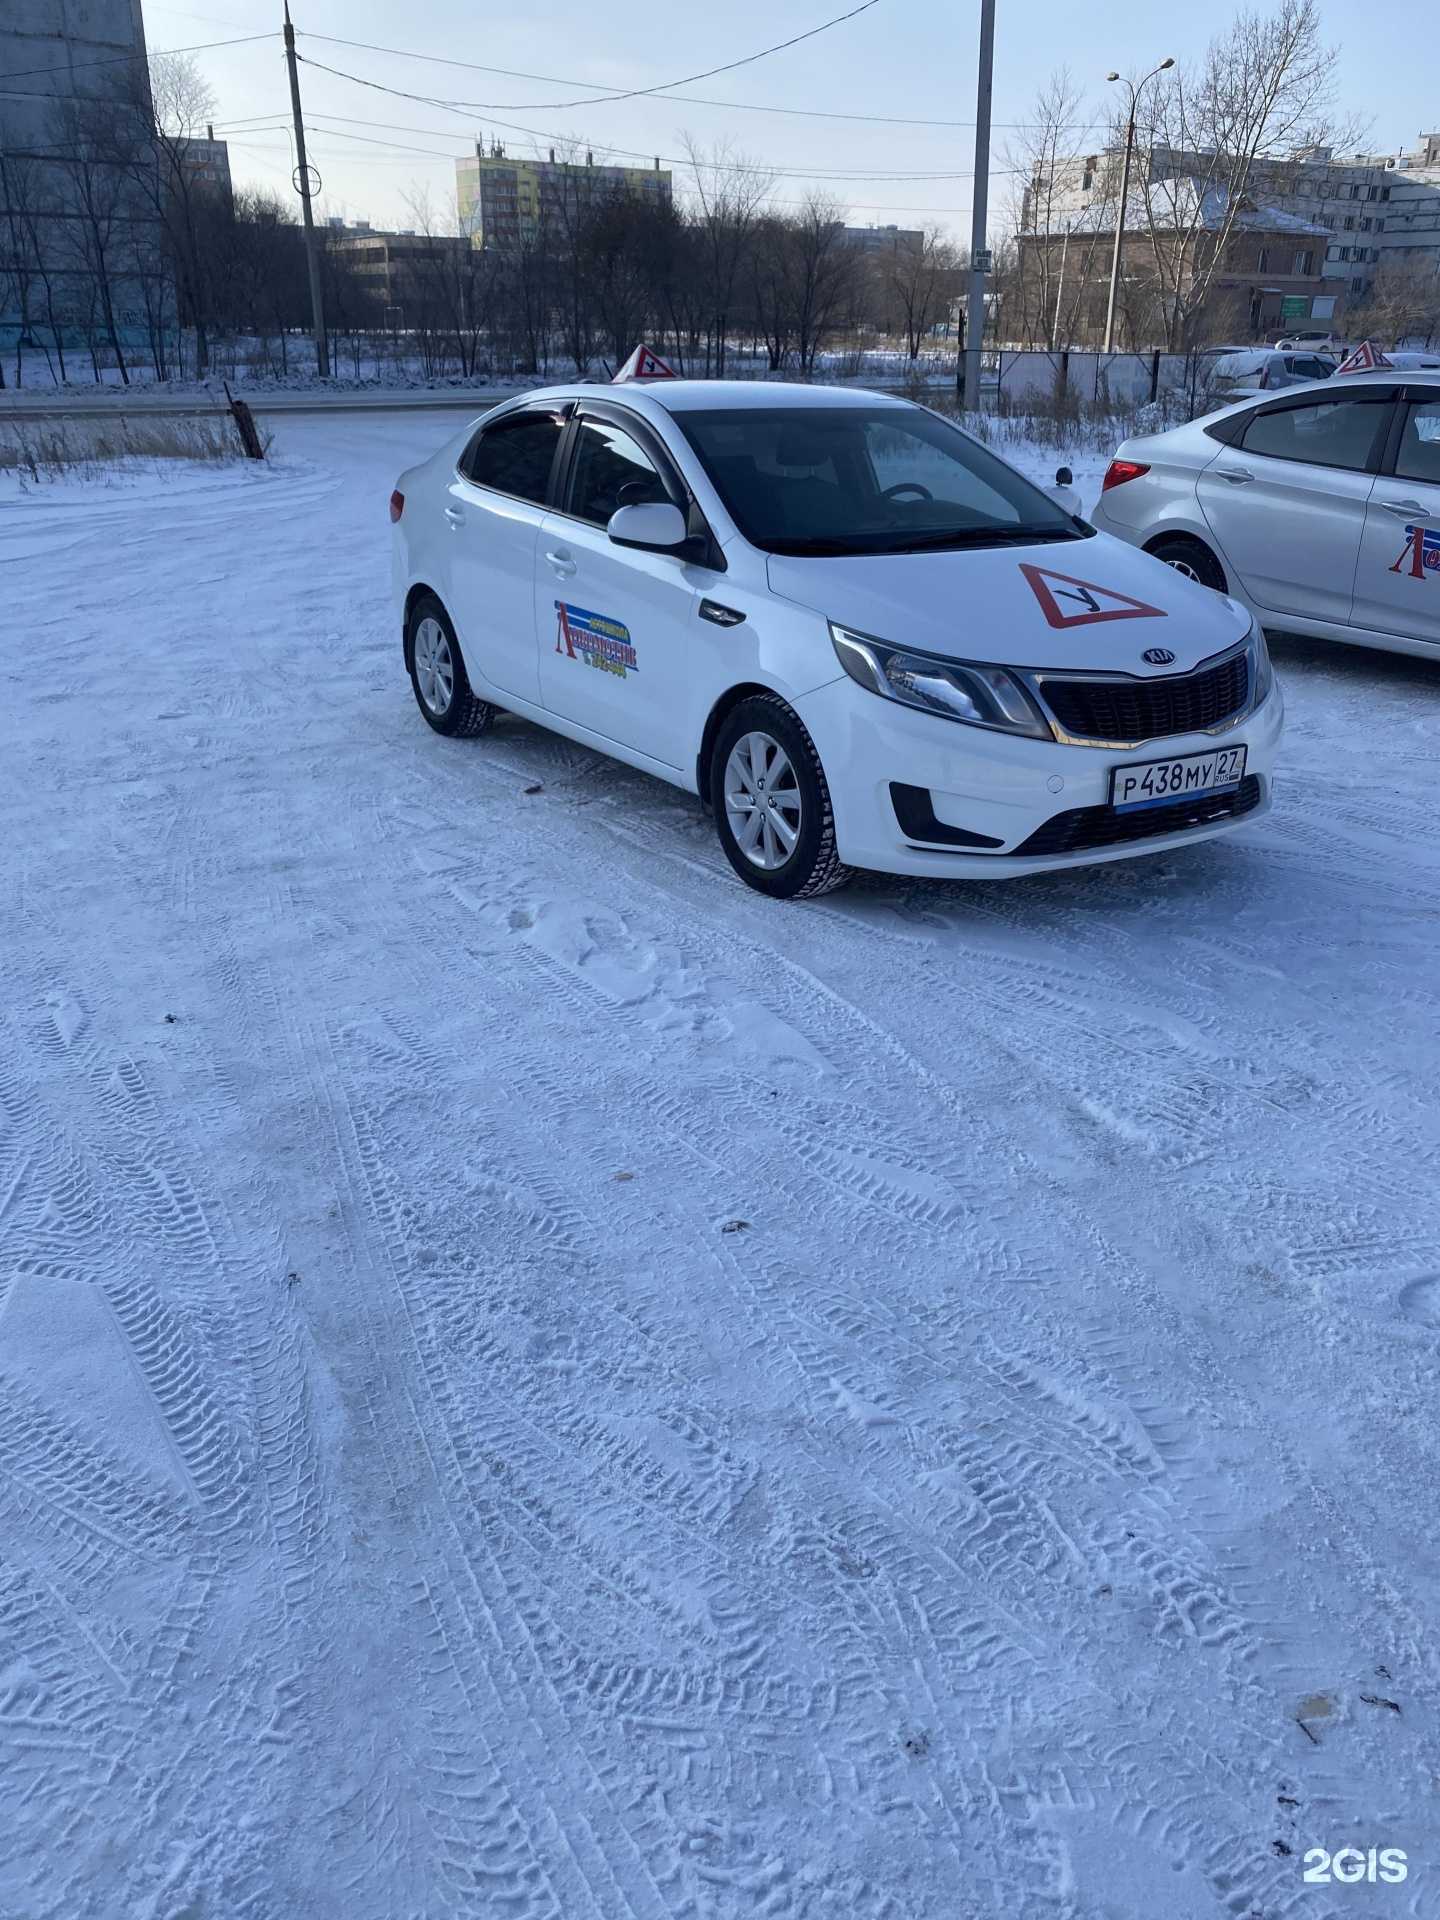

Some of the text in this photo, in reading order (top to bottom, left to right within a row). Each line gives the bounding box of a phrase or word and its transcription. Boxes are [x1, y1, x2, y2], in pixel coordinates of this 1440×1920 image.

[1053, 587, 1101, 612] У
[1146, 650, 1174, 662] KIA
[1217, 751, 1239, 774] 27
